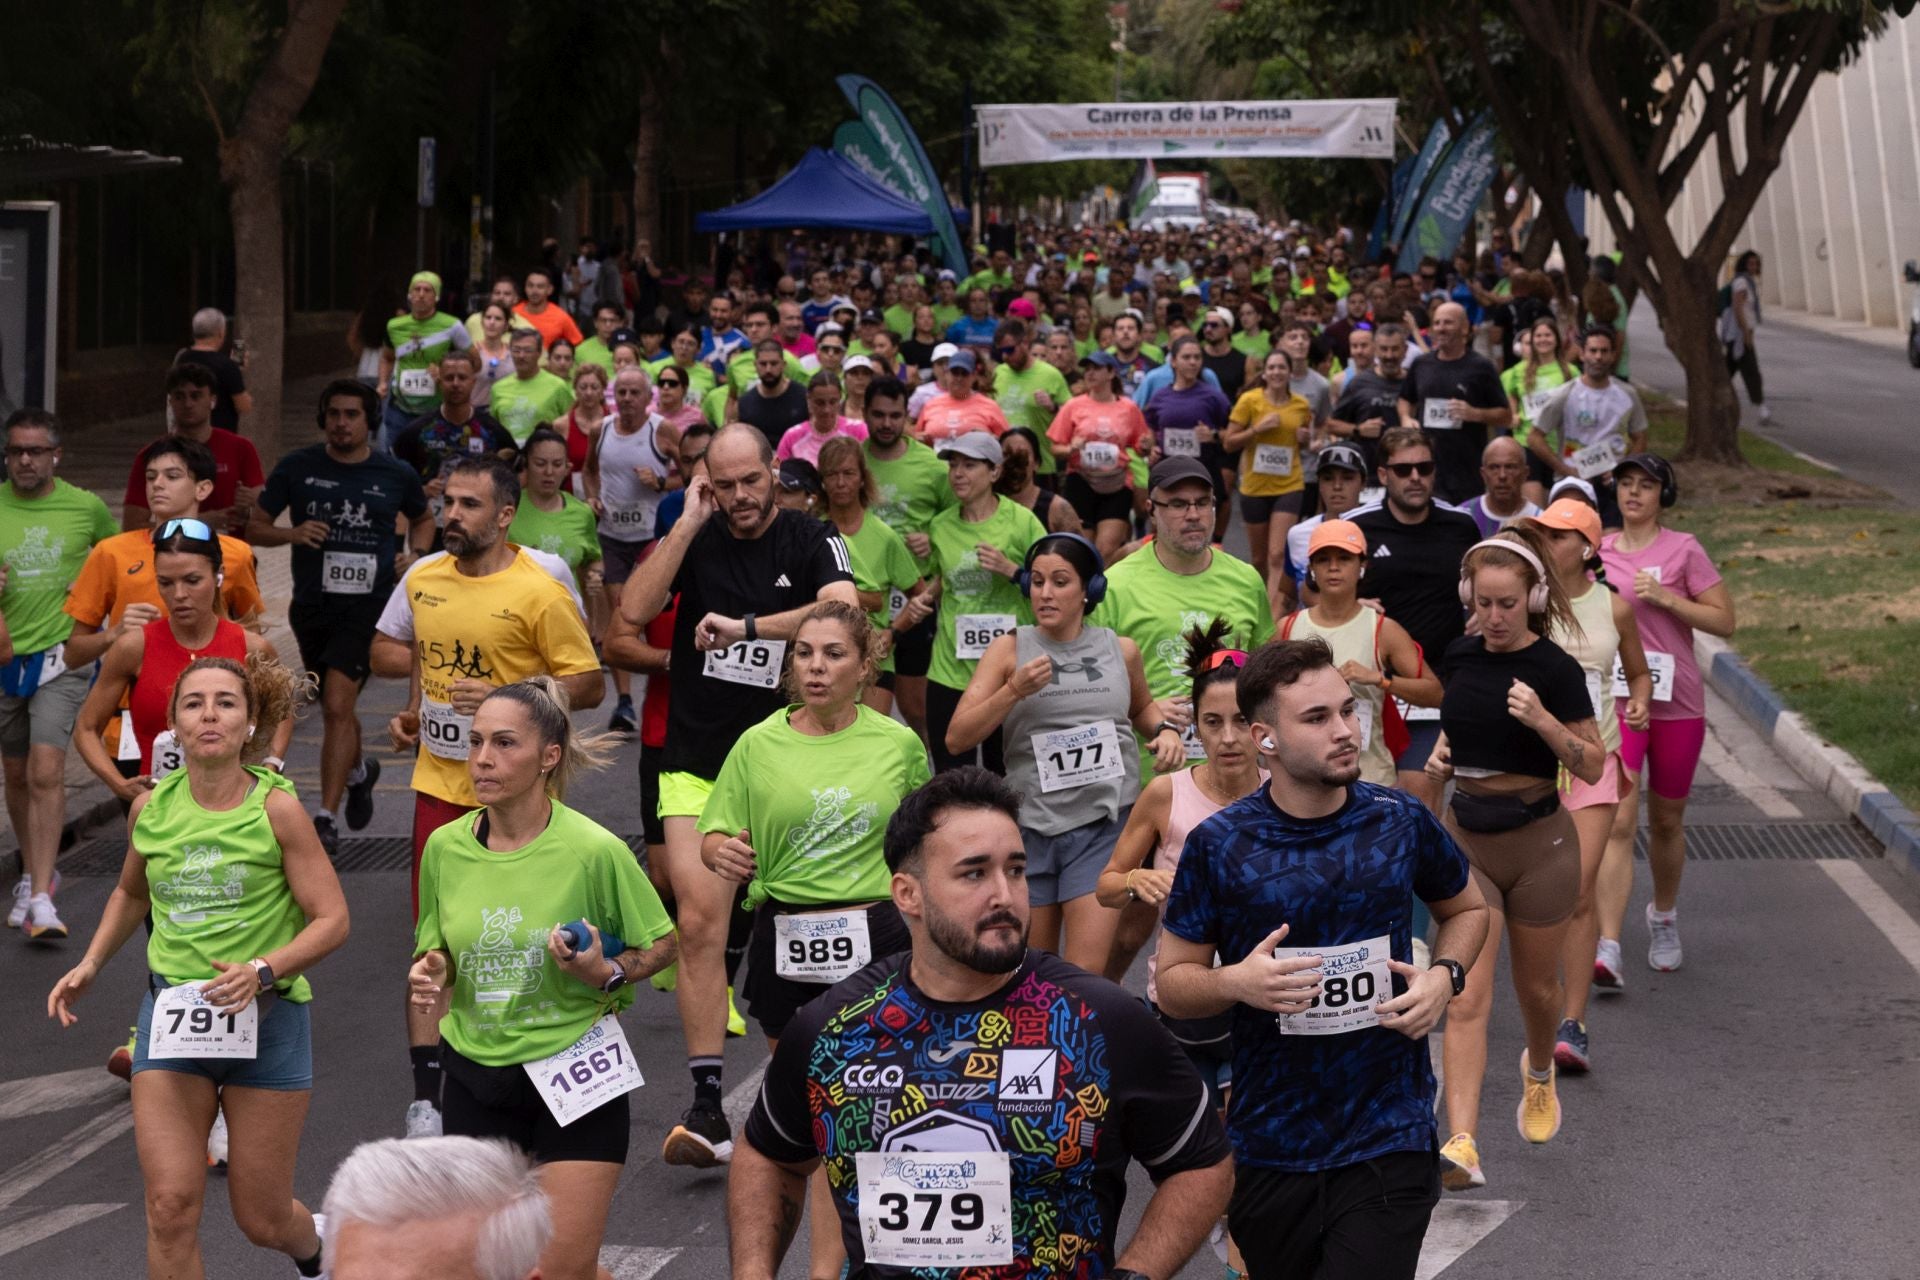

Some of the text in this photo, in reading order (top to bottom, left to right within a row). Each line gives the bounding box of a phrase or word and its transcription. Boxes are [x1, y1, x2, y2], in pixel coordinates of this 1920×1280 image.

[1087, 105, 1291, 123] Carrera de la Prensa
[611, 510, 642, 524] 960
[329, 565, 368, 581] 808
[1038, 687, 1111, 698] UNDER ARMOUR
[1048, 742, 1103, 771] 177
[788, 936, 854, 964] 989
[460, 953, 526, 972] Carrera
[1303, 971, 1375, 1008] 80
[165, 1007, 236, 1035] 791
[550, 1042, 623, 1094] 1667
[1000, 1075, 1043, 1095] AXA
[996, 1101, 1052, 1114] fundación
[901, 1160, 963, 1178] Carrera
[878, 1192, 984, 1231] 379
[902, 1237, 920, 1245] GOMEZ
[945, 1237, 964, 1245] JESUS
